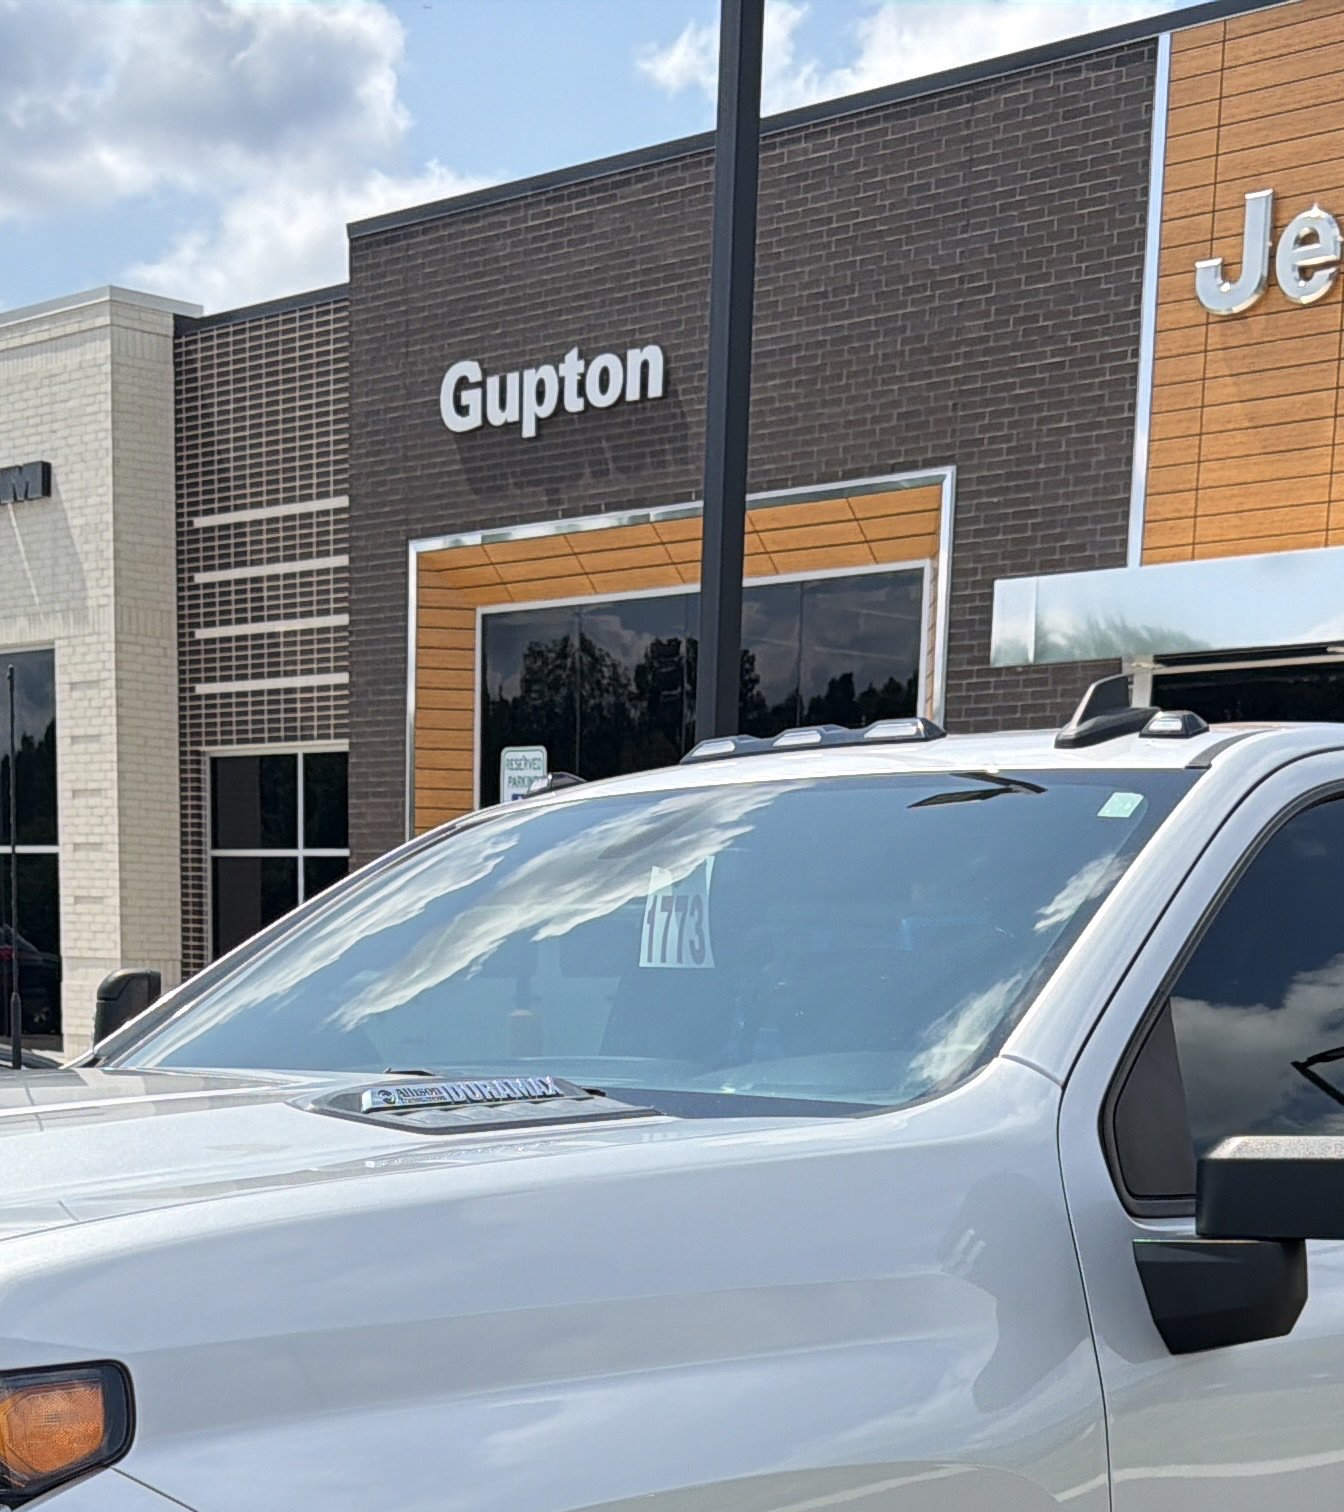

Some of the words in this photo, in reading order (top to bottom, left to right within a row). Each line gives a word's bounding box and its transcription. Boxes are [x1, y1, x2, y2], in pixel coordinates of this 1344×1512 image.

[440, 344, 664, 439] Gupton
[646, 895, 707, 965] 1773
[394, 1086, 442, 1098] Allison
[442, 1075, 564, 1104] DURAMAX
